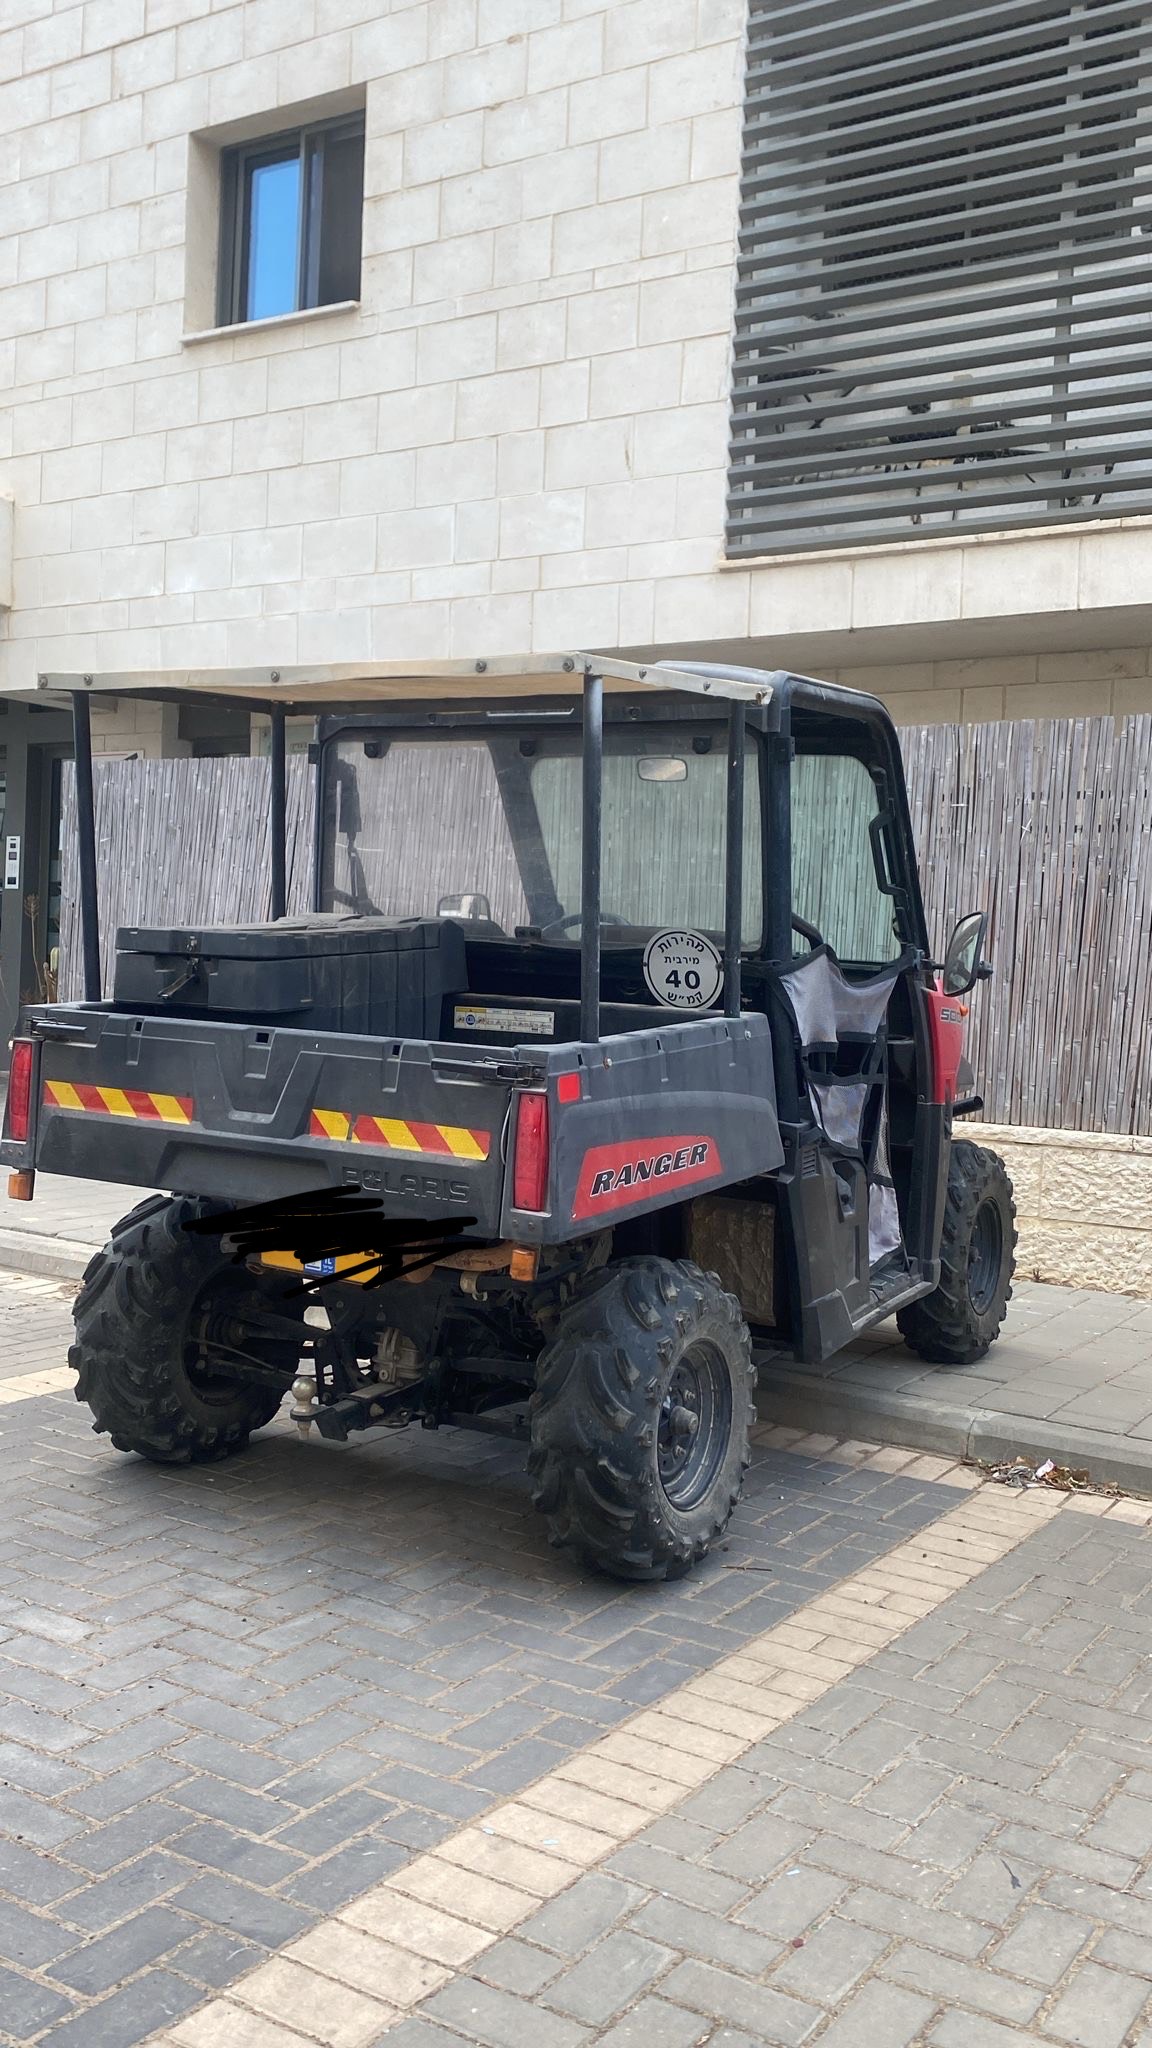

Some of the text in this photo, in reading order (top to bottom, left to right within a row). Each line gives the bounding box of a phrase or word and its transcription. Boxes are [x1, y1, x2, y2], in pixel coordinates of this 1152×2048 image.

[658, 936, 705, 953] מהירות
[664, 956, 700, 965] מירבית
[665, 969, 701, 990] 40
[590, 1142, 708, 1197] RANGER
[341, 1166, 471, 1204] POLARIS
